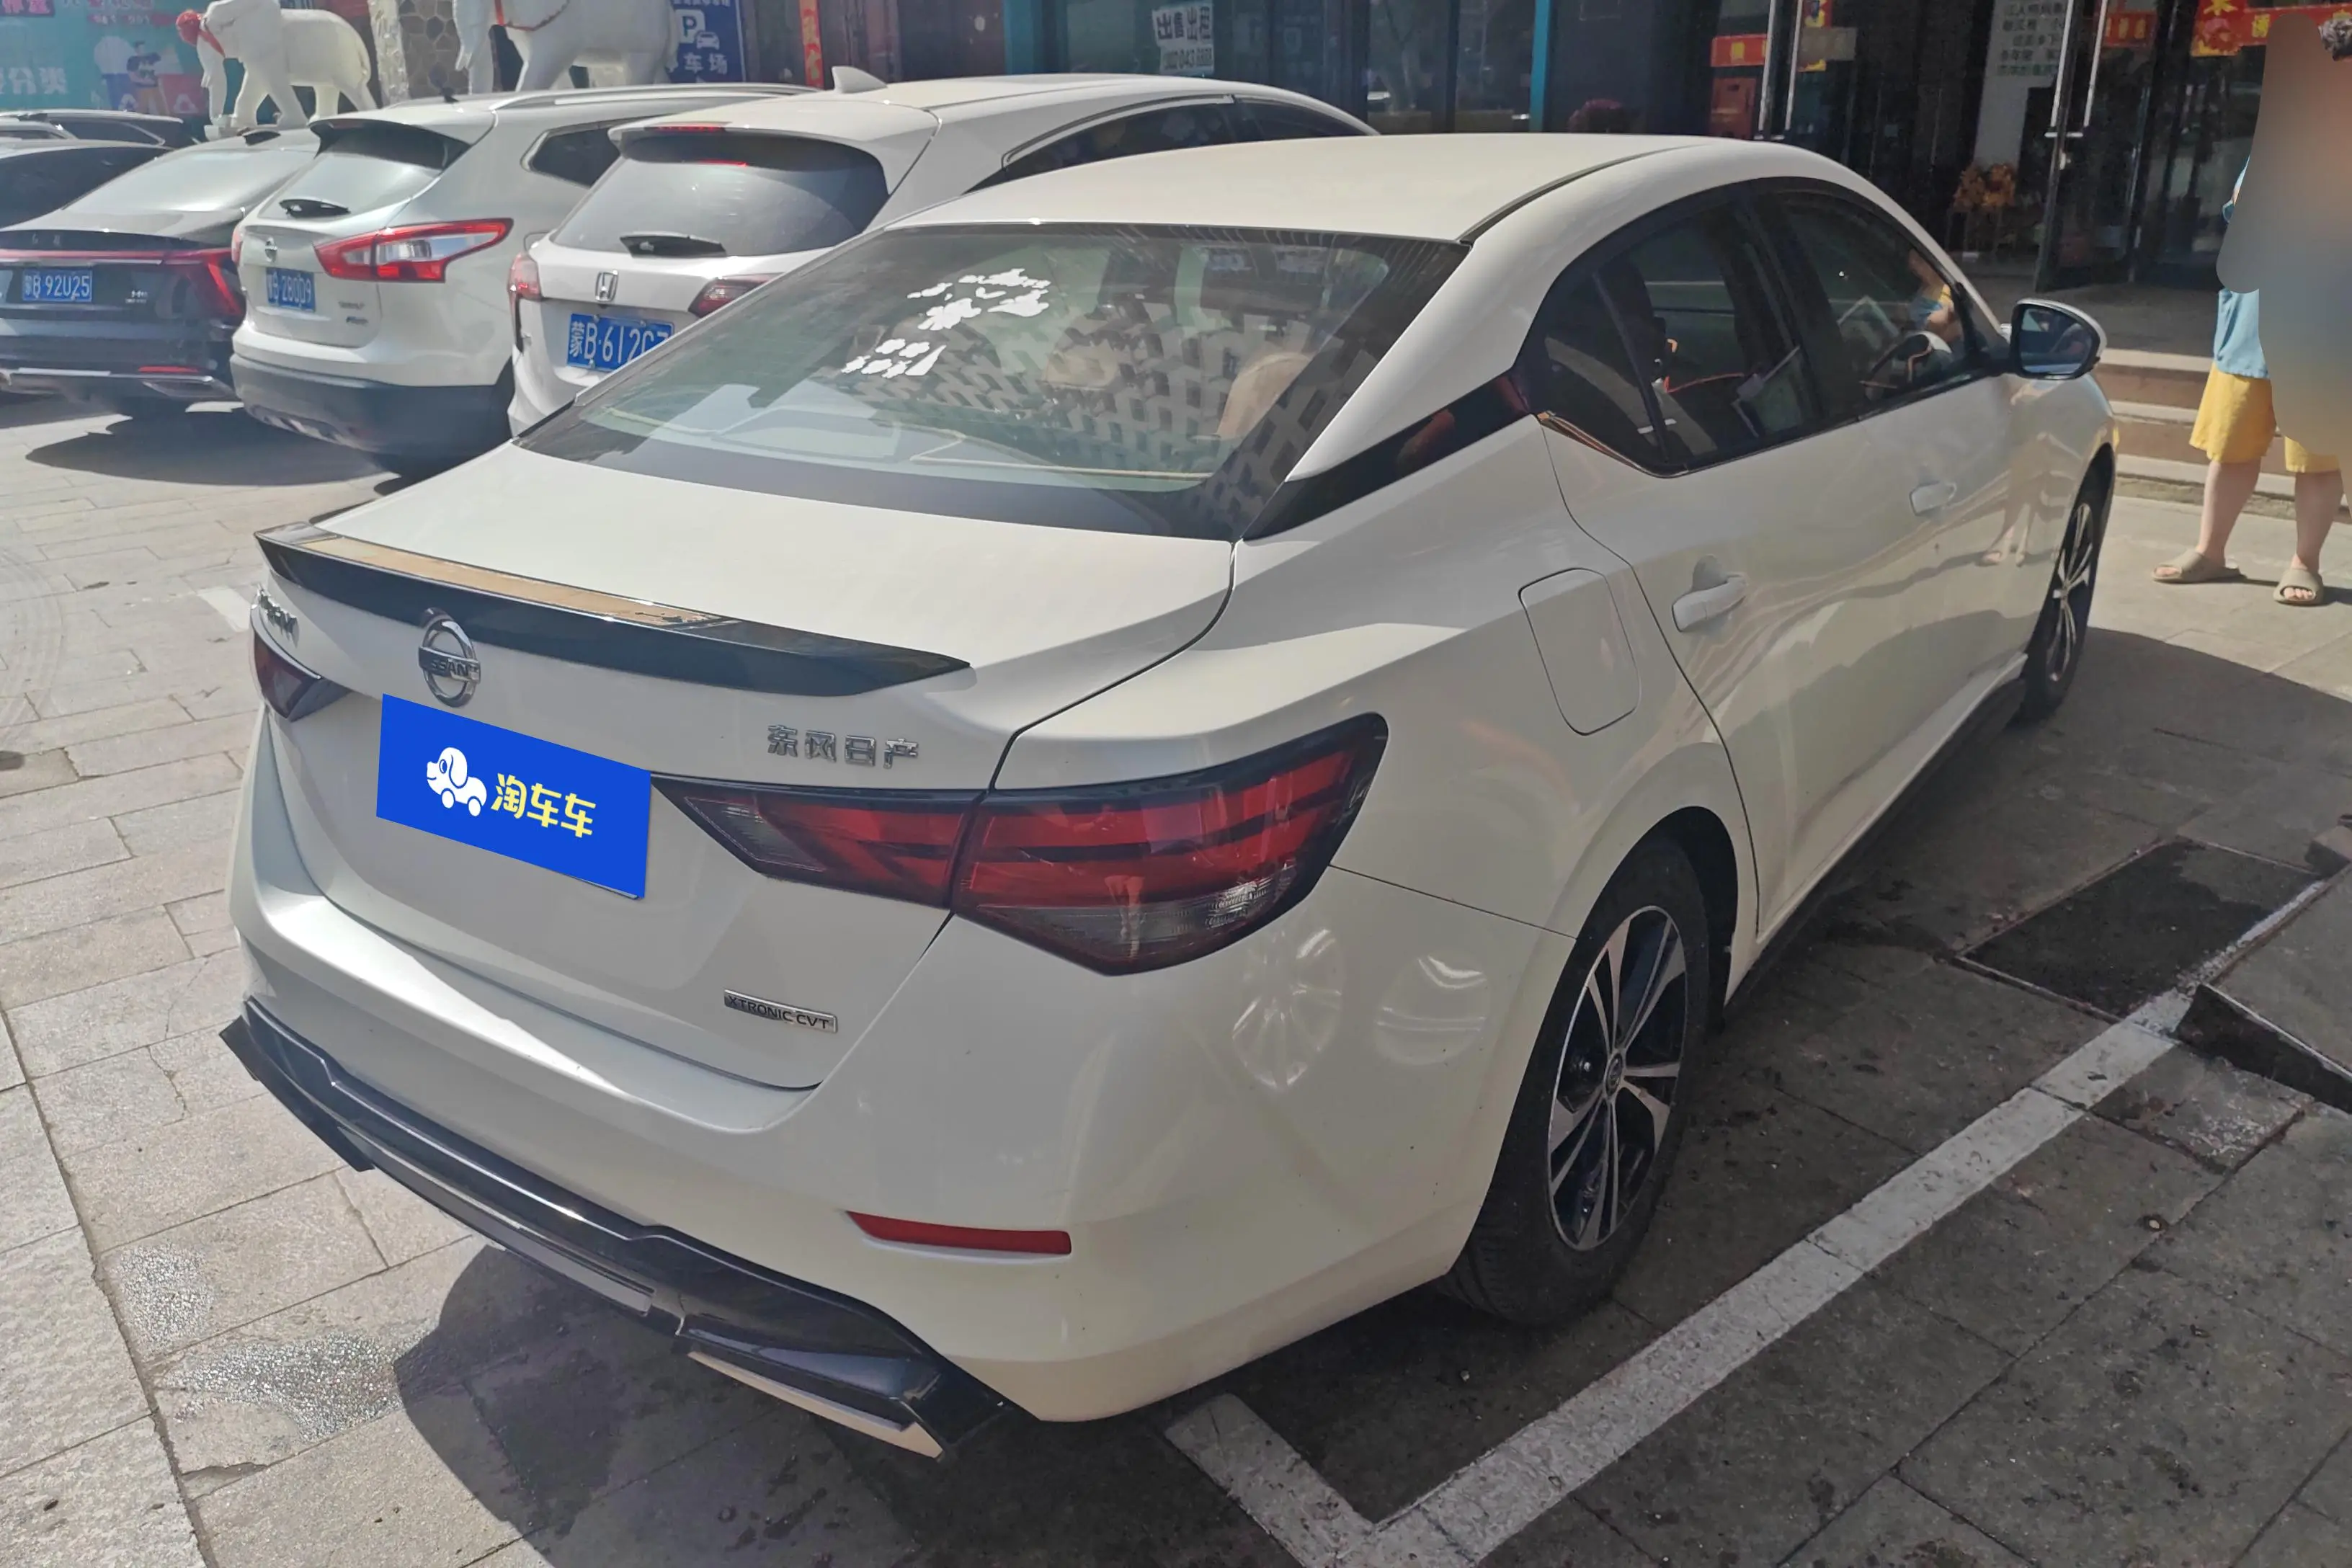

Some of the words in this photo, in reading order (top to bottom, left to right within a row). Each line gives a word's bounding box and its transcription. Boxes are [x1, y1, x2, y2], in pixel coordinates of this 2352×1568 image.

[666, 52, 729, 74] 车场
[0, 66, 68, 95] 分类
[767, 725, 918, 769] 东风日产
[729, 996, 793, 1023] XTRONIC
[796, 1014, 829, 1029] CVT
